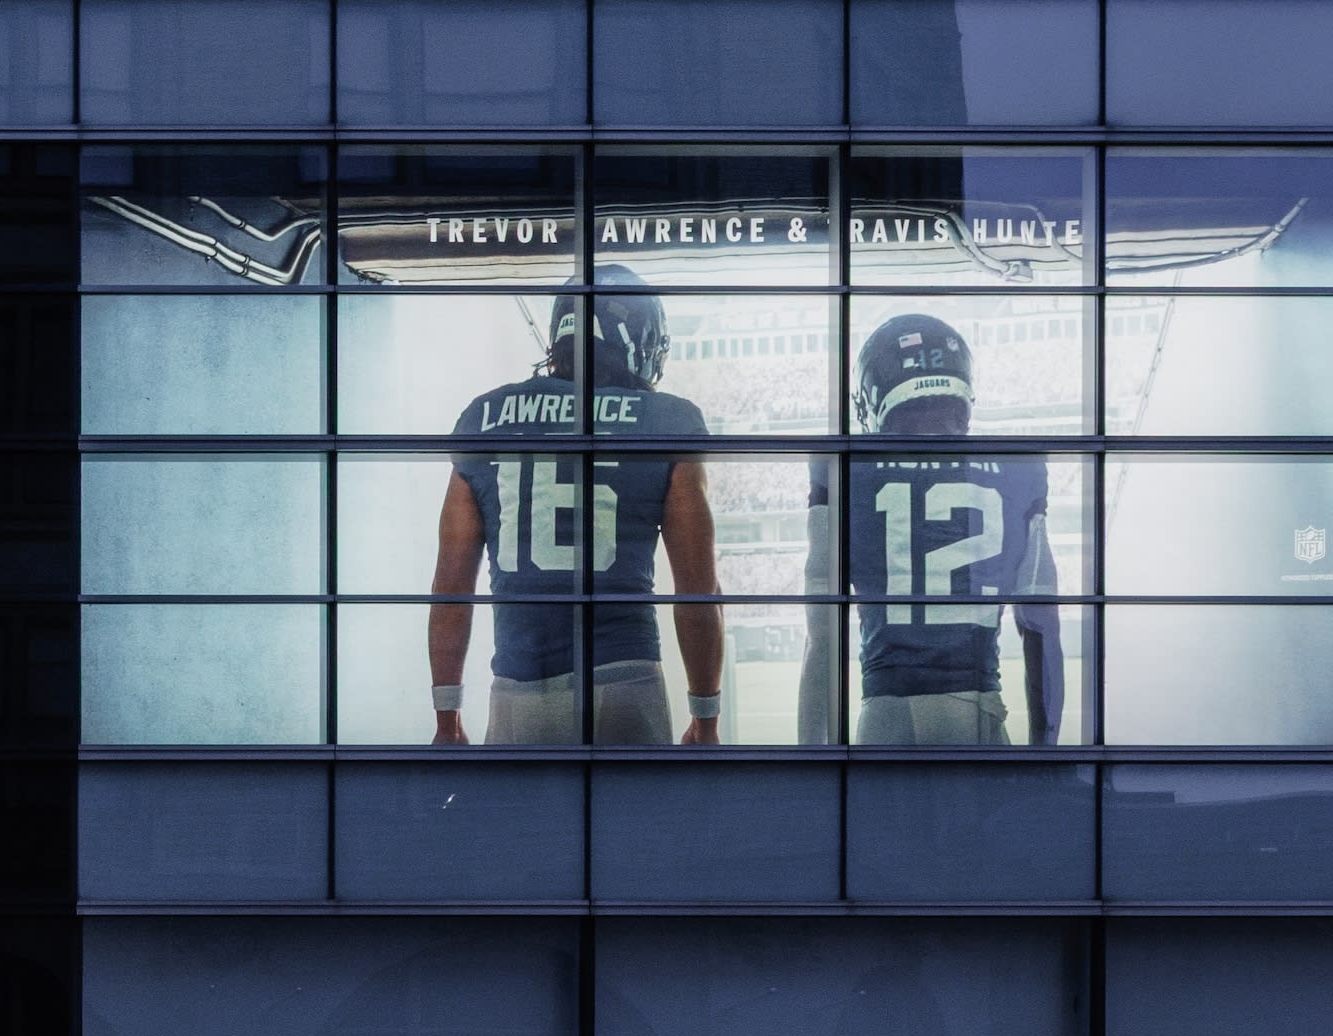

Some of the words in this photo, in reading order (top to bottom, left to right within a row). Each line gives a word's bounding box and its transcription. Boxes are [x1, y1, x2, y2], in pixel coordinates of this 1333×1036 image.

[427, 218, 559, 244] TREVOR
[600, 218, 765, 243] AWRENCE
[786, 218, 808, 243] &
[830, 218, 950, 243] RAVIS
[973, 218, 1080, 244] HUNTE
[913, 378, 951, 391] JAGUARS
[491, 433, 619, 572] 16
[875, 482, 1004, 625] 12
